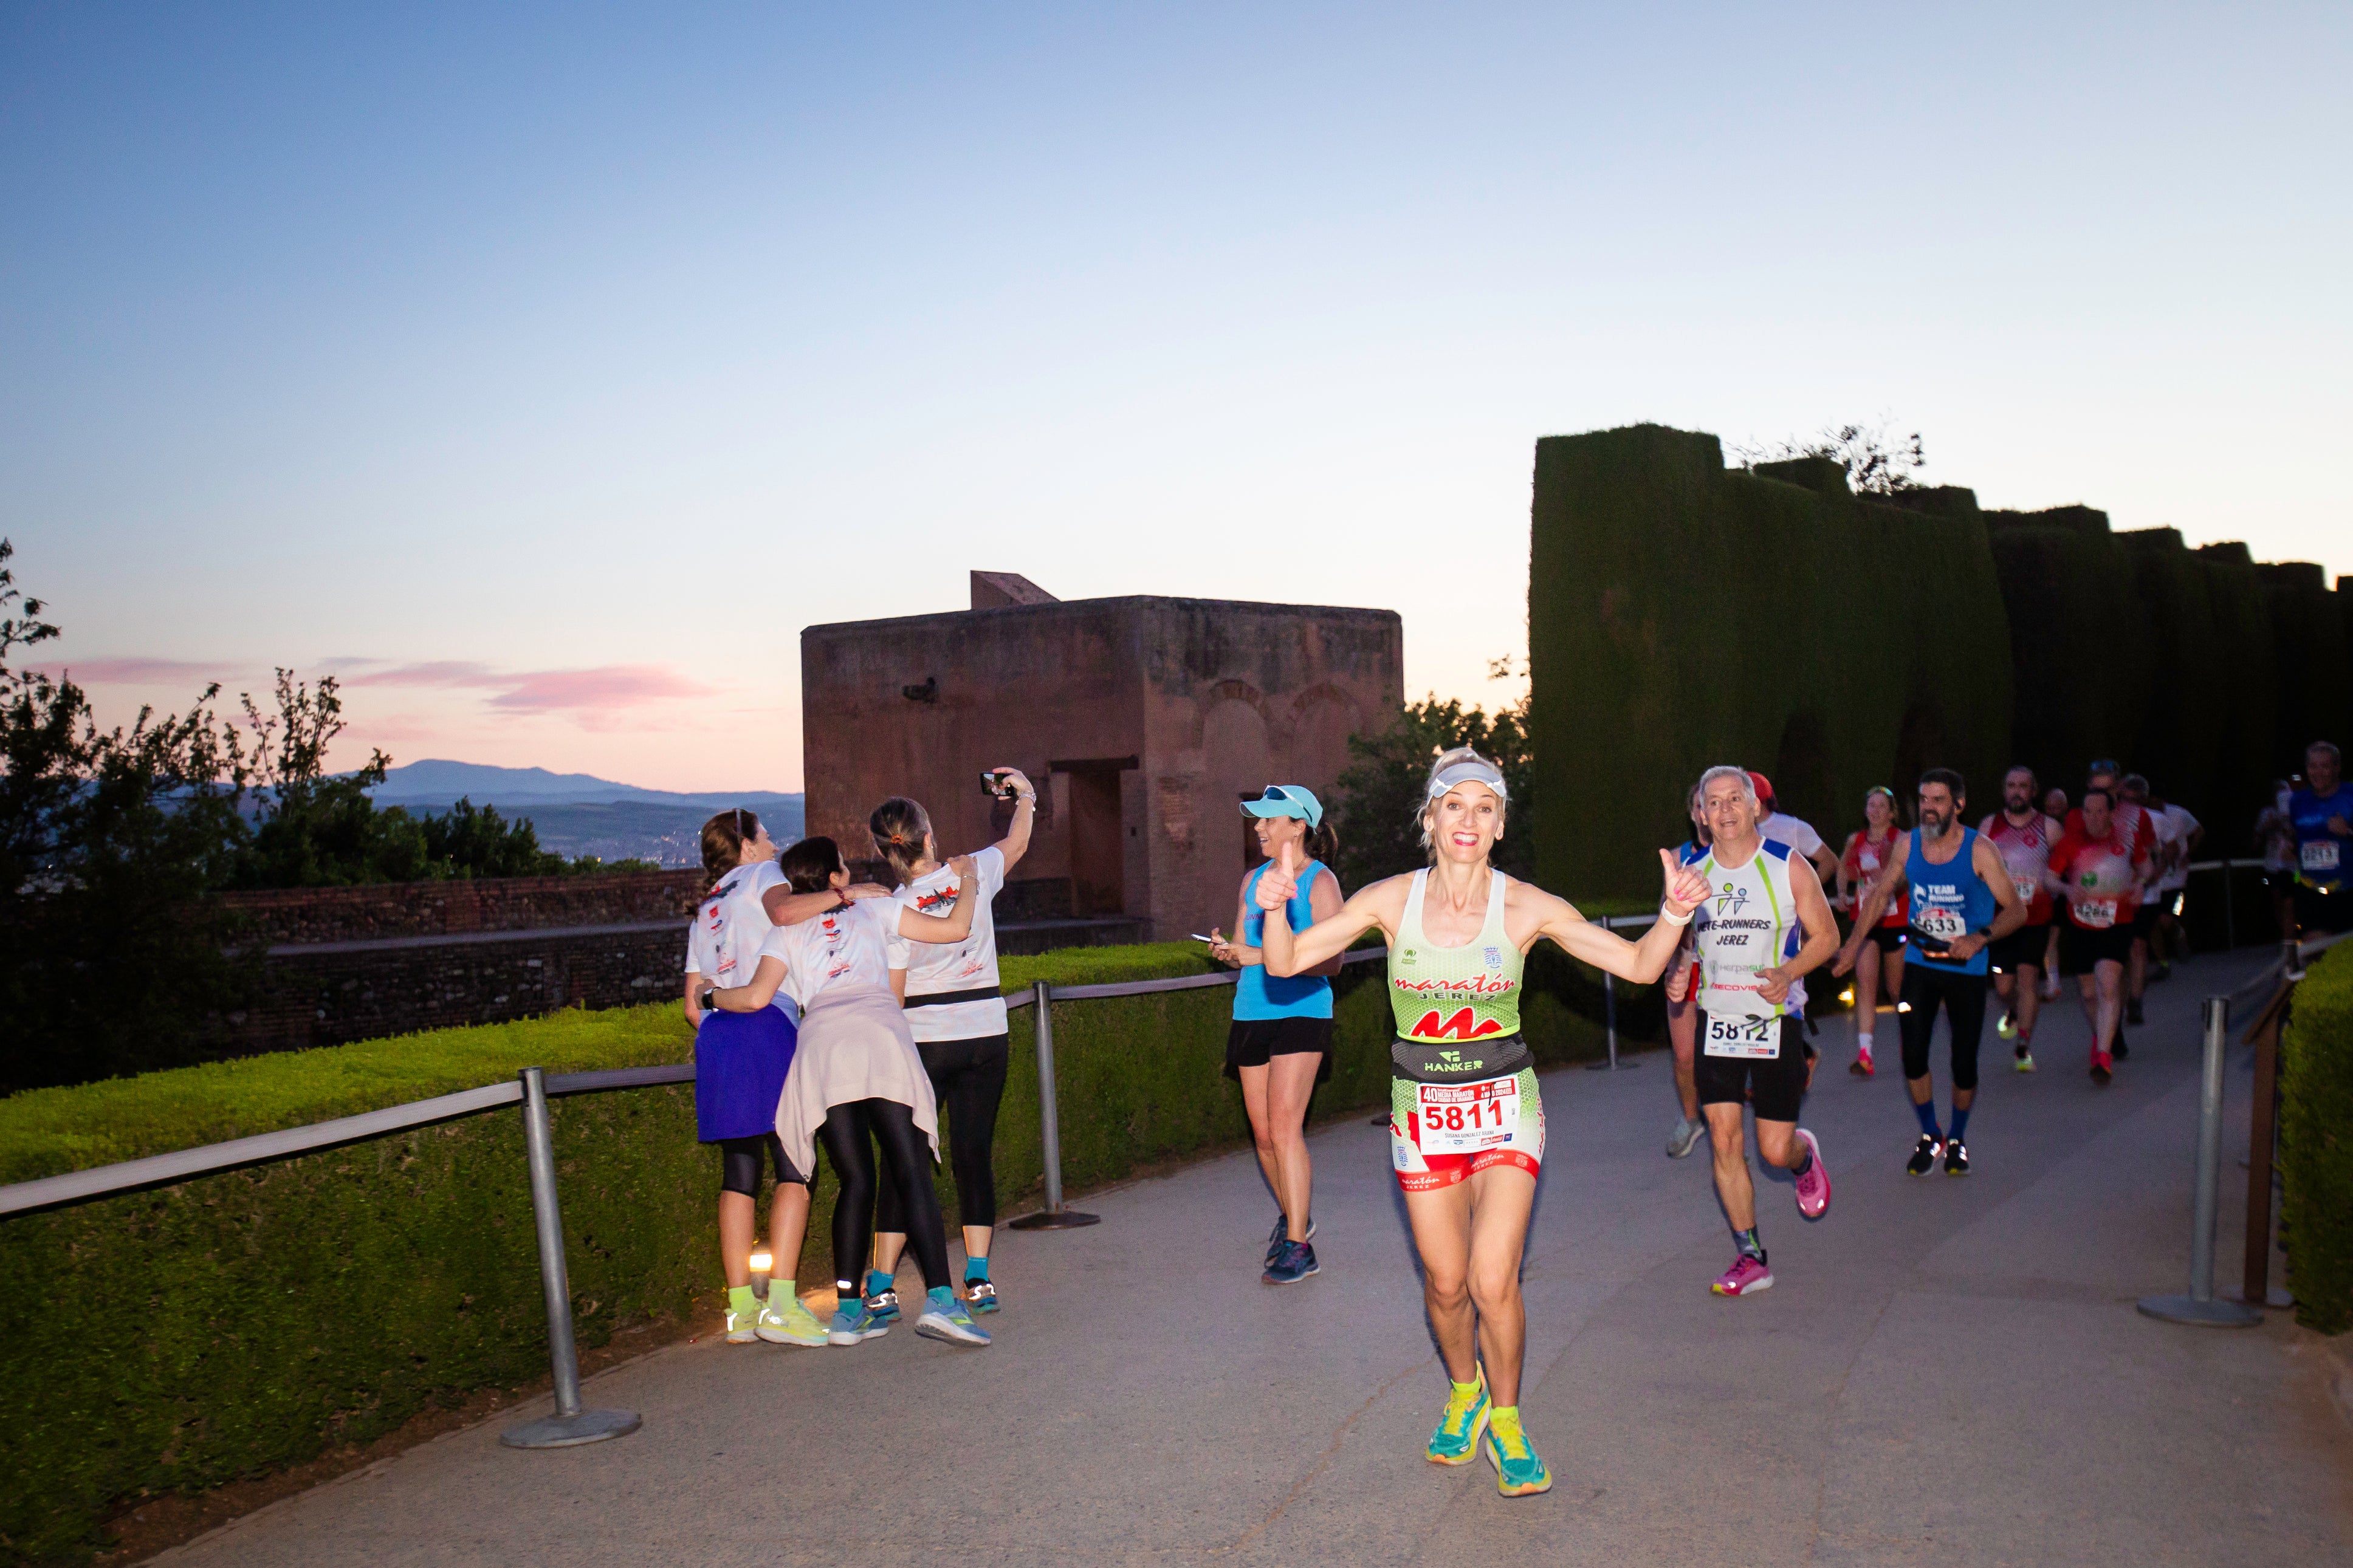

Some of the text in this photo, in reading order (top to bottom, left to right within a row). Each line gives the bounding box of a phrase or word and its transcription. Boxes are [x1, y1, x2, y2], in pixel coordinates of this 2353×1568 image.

[1915, 918, 1957, 934] 633
[1717, 935, 1749, 945] JEREZ
[1395, 973, 1514, 993] maratón
[1420, 992, 1496, 1001] JEREZ
[1424, 1060, 1483, 1072] HANKER
[1423, 1087, 1438, 1102] 40
[1496, 1088, 1506, 1097] 2024
[1426, 1100, 1502, 1131] 5811
